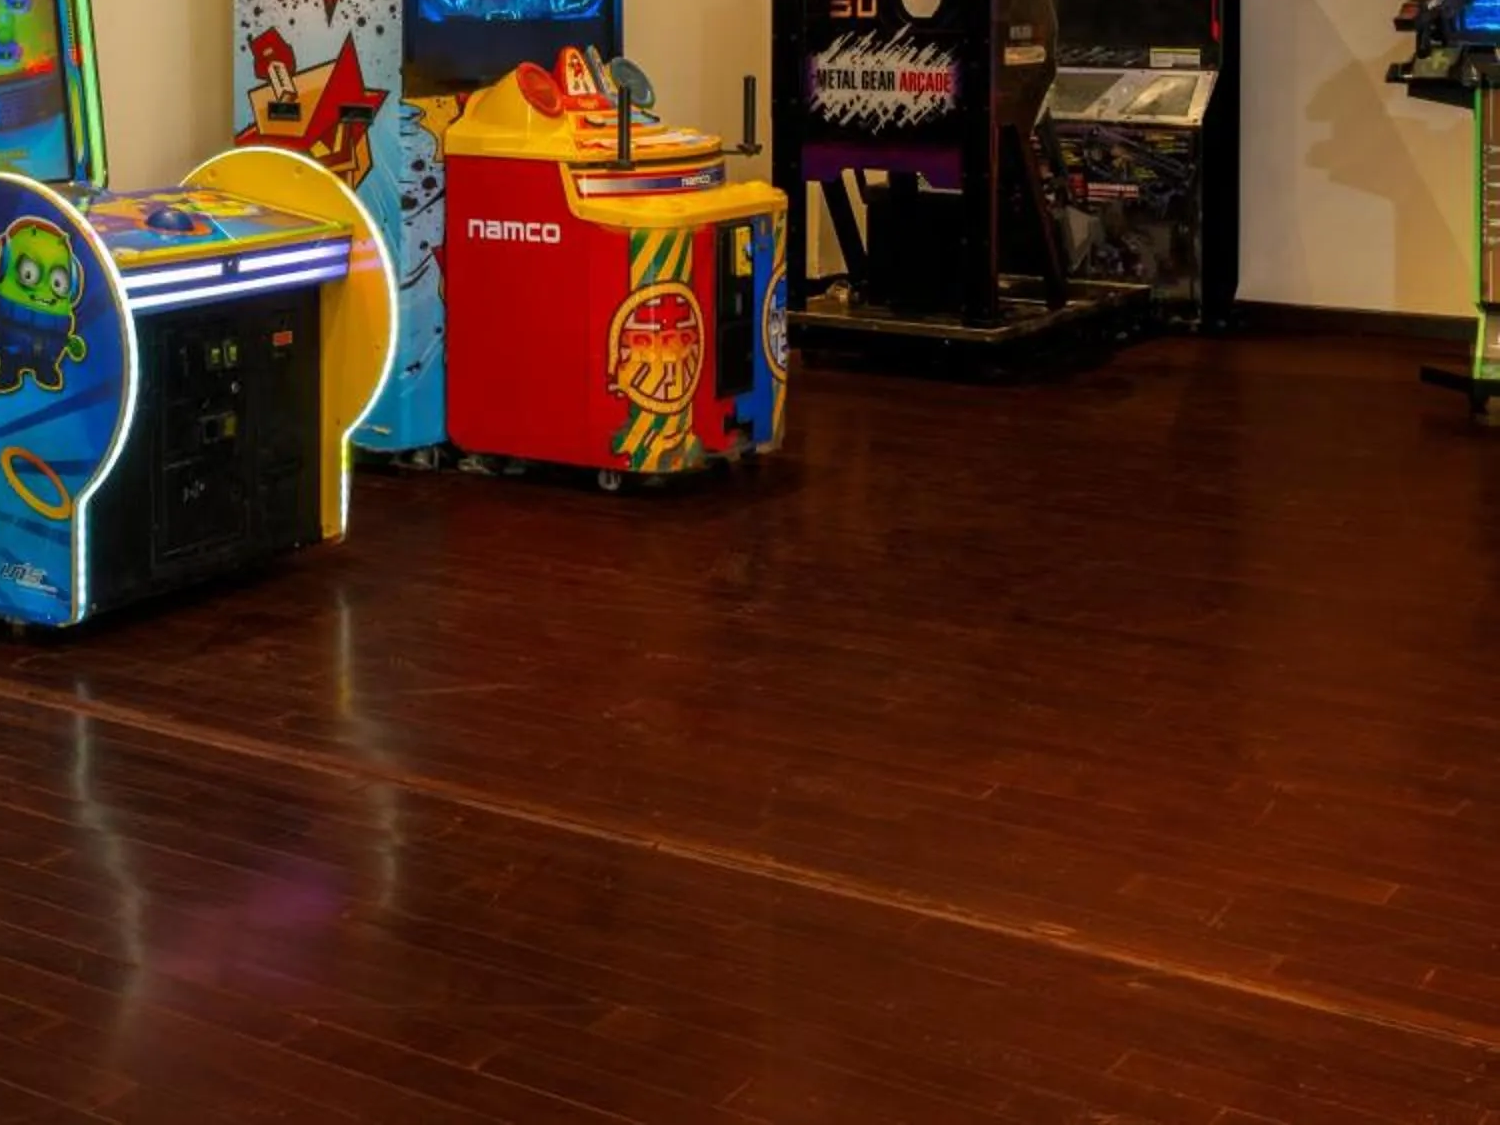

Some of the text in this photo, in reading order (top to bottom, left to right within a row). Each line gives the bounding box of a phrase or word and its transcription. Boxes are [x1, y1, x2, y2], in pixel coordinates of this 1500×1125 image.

[817, 69, 952, 92] METAL GEAR ARCADE
[468, 218, 561, 244] namco
